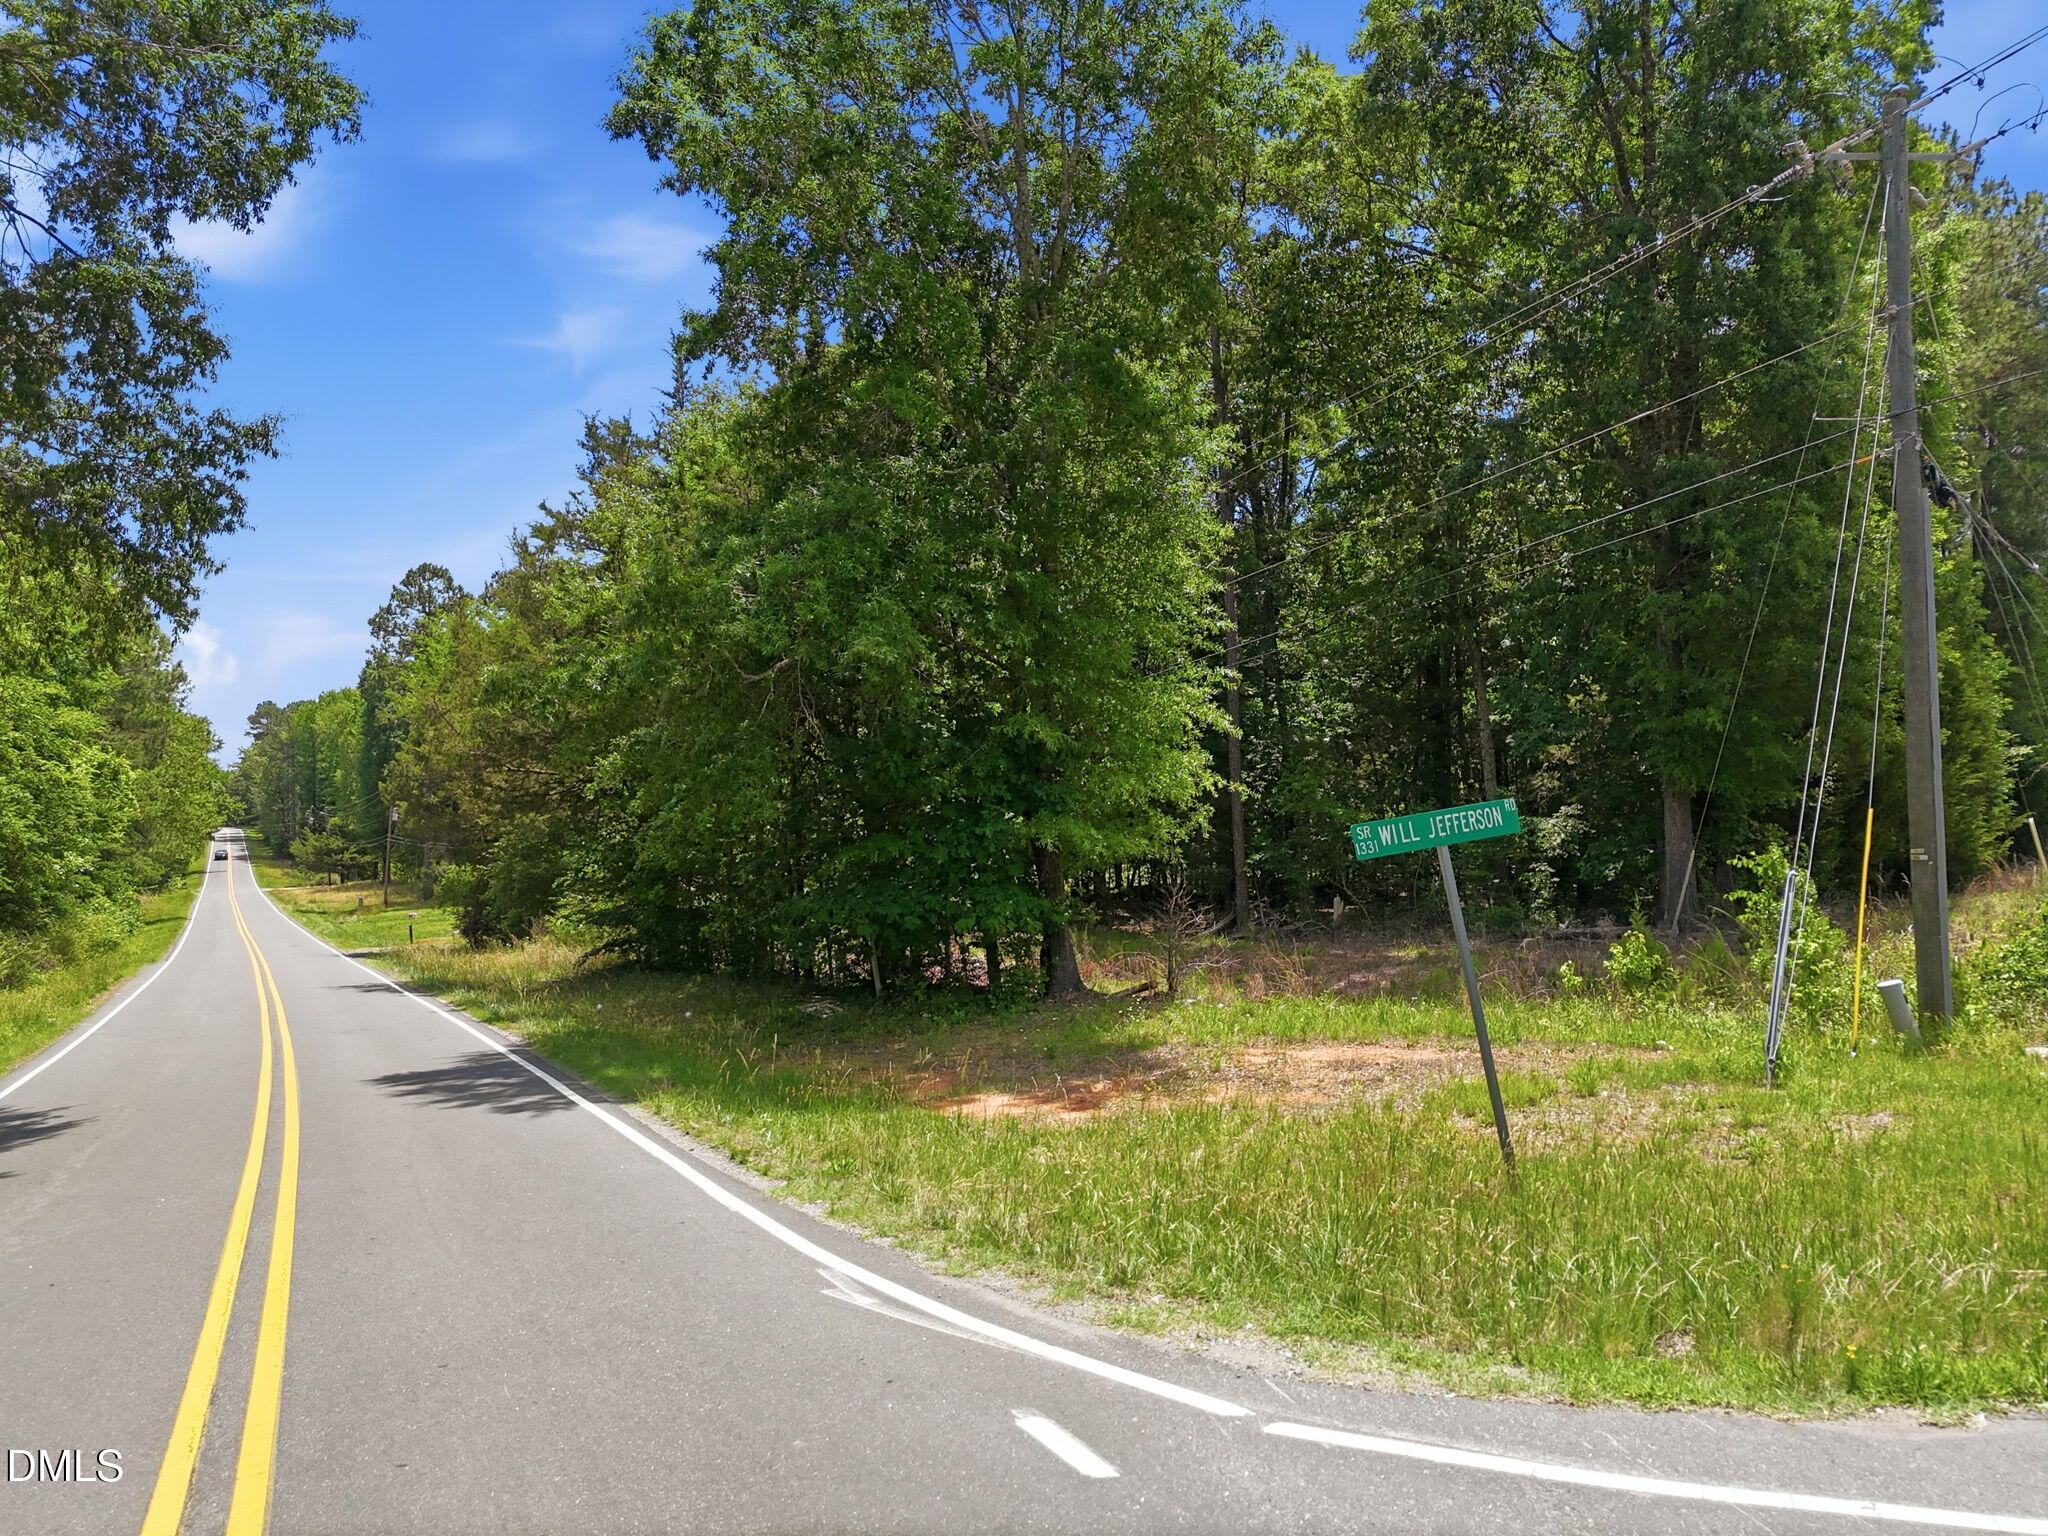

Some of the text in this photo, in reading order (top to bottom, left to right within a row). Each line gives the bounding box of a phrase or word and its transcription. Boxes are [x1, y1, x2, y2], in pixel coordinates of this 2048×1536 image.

[1377, 798, 1516, 847] WILL JEFFERSON RD
[1356, 825, 1371, 840] SR
[1355, 840, 1379, 857] 1331
